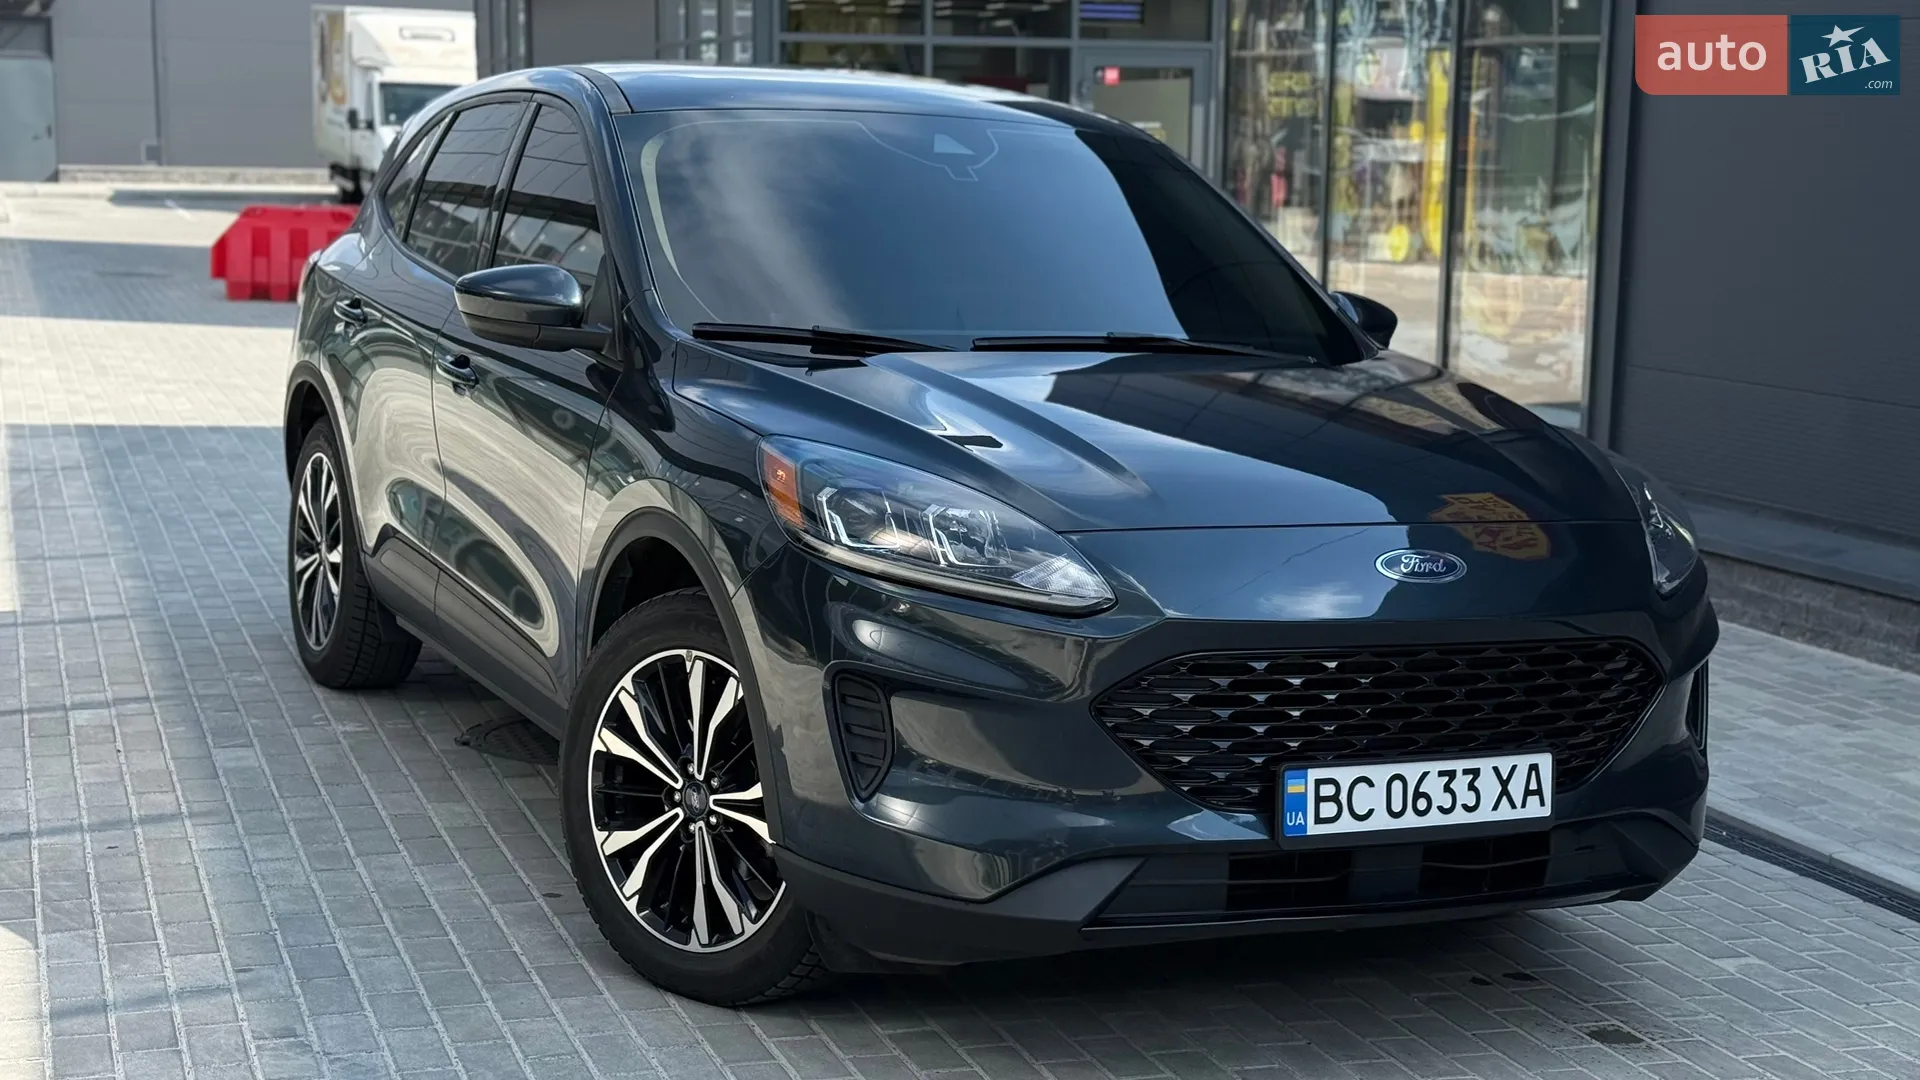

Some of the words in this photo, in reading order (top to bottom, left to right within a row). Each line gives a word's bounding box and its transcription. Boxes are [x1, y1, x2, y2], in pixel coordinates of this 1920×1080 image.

[1400, 554, 1446, 573] Ford
[1313, 775, 1375, 825] BC
[1385, 767, 1481, 819] 0633
[1490, 762, 1546, 812] XA
[1286, 811, 1305, 826] UA
